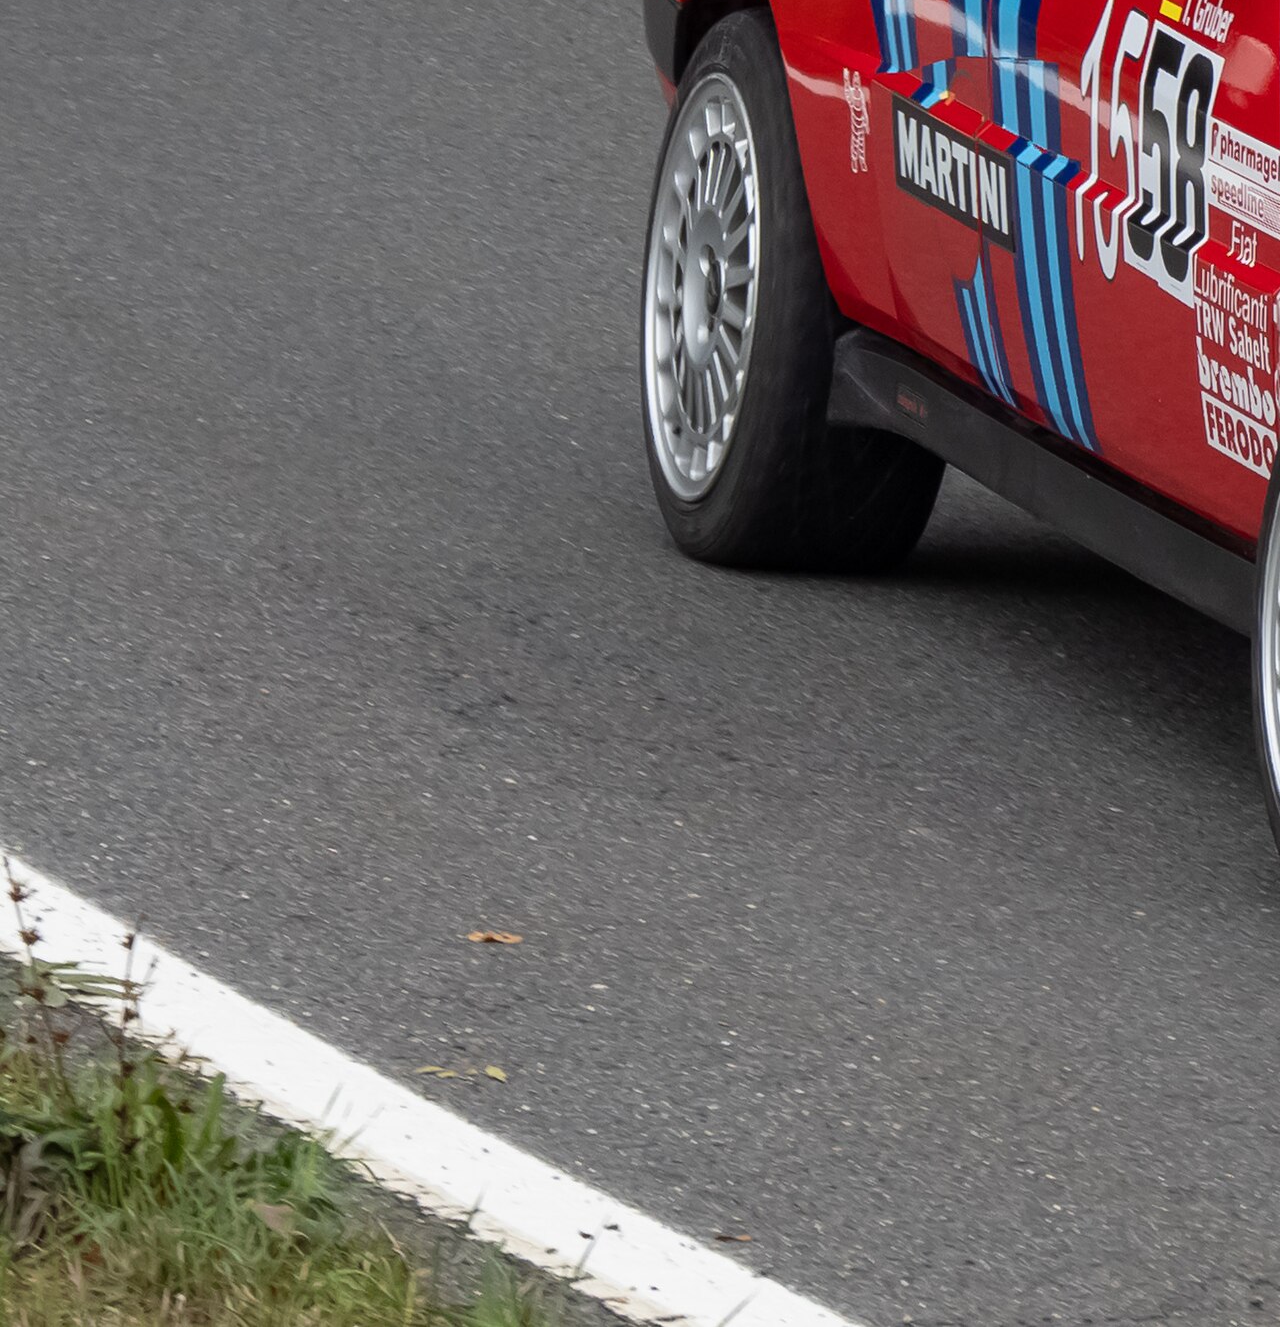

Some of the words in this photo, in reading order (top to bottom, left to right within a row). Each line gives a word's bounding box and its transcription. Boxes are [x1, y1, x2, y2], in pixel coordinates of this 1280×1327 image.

[897, 110, 1009, 236] MARTINI
[1126, 28, 1214, 283] 58
[1220, 131, 1280, 183] pharmagel
[1211, 174, 1265, 218] speedline
[1226, 220, 1258, 268] Fiat
[1194, 254, 1268, 333] Lubrificanti
[1194, 295, 1225, 347] TRW
[1228, 316, 1271, 374] Sabelt
[1196, 336, 1276, 426] brembo
[1205, 400, 1275, 473] FERODO
